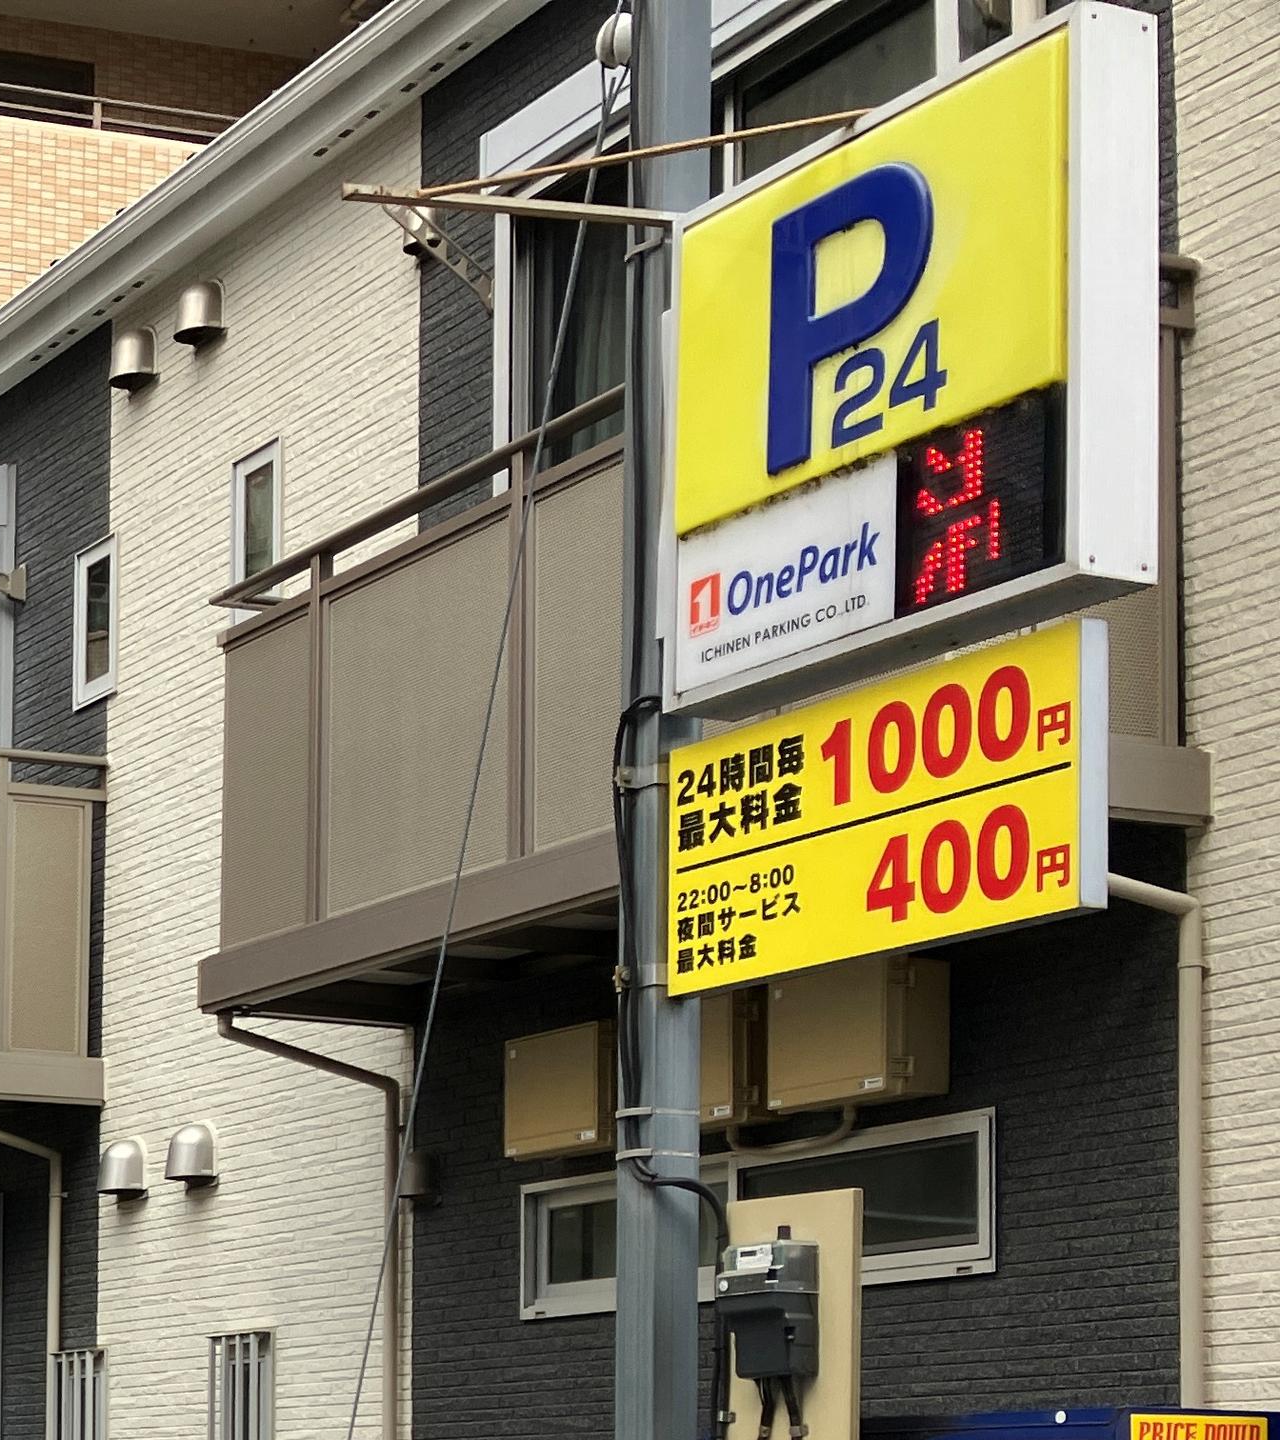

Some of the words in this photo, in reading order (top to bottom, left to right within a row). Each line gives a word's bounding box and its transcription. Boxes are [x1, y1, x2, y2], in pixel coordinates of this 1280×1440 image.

[768, 161, 934, 475] P
[832, 318, 947, 448] 24
[728, 522, 880, 615] OnePark
[702, 634, 750, 663] ICHINEN
[754, 614, 811, 645] PARKING
[677, 734, 805, 806] 24時間毎
[820, 666, 1071, 806] 1000円
[678, 783, 803, 852] 最大料金
[866, 804, 1071, 923] 400円
[677, 892, 801, 943] 夜間サービス
[677, 933, 757, 974] 最大料金
